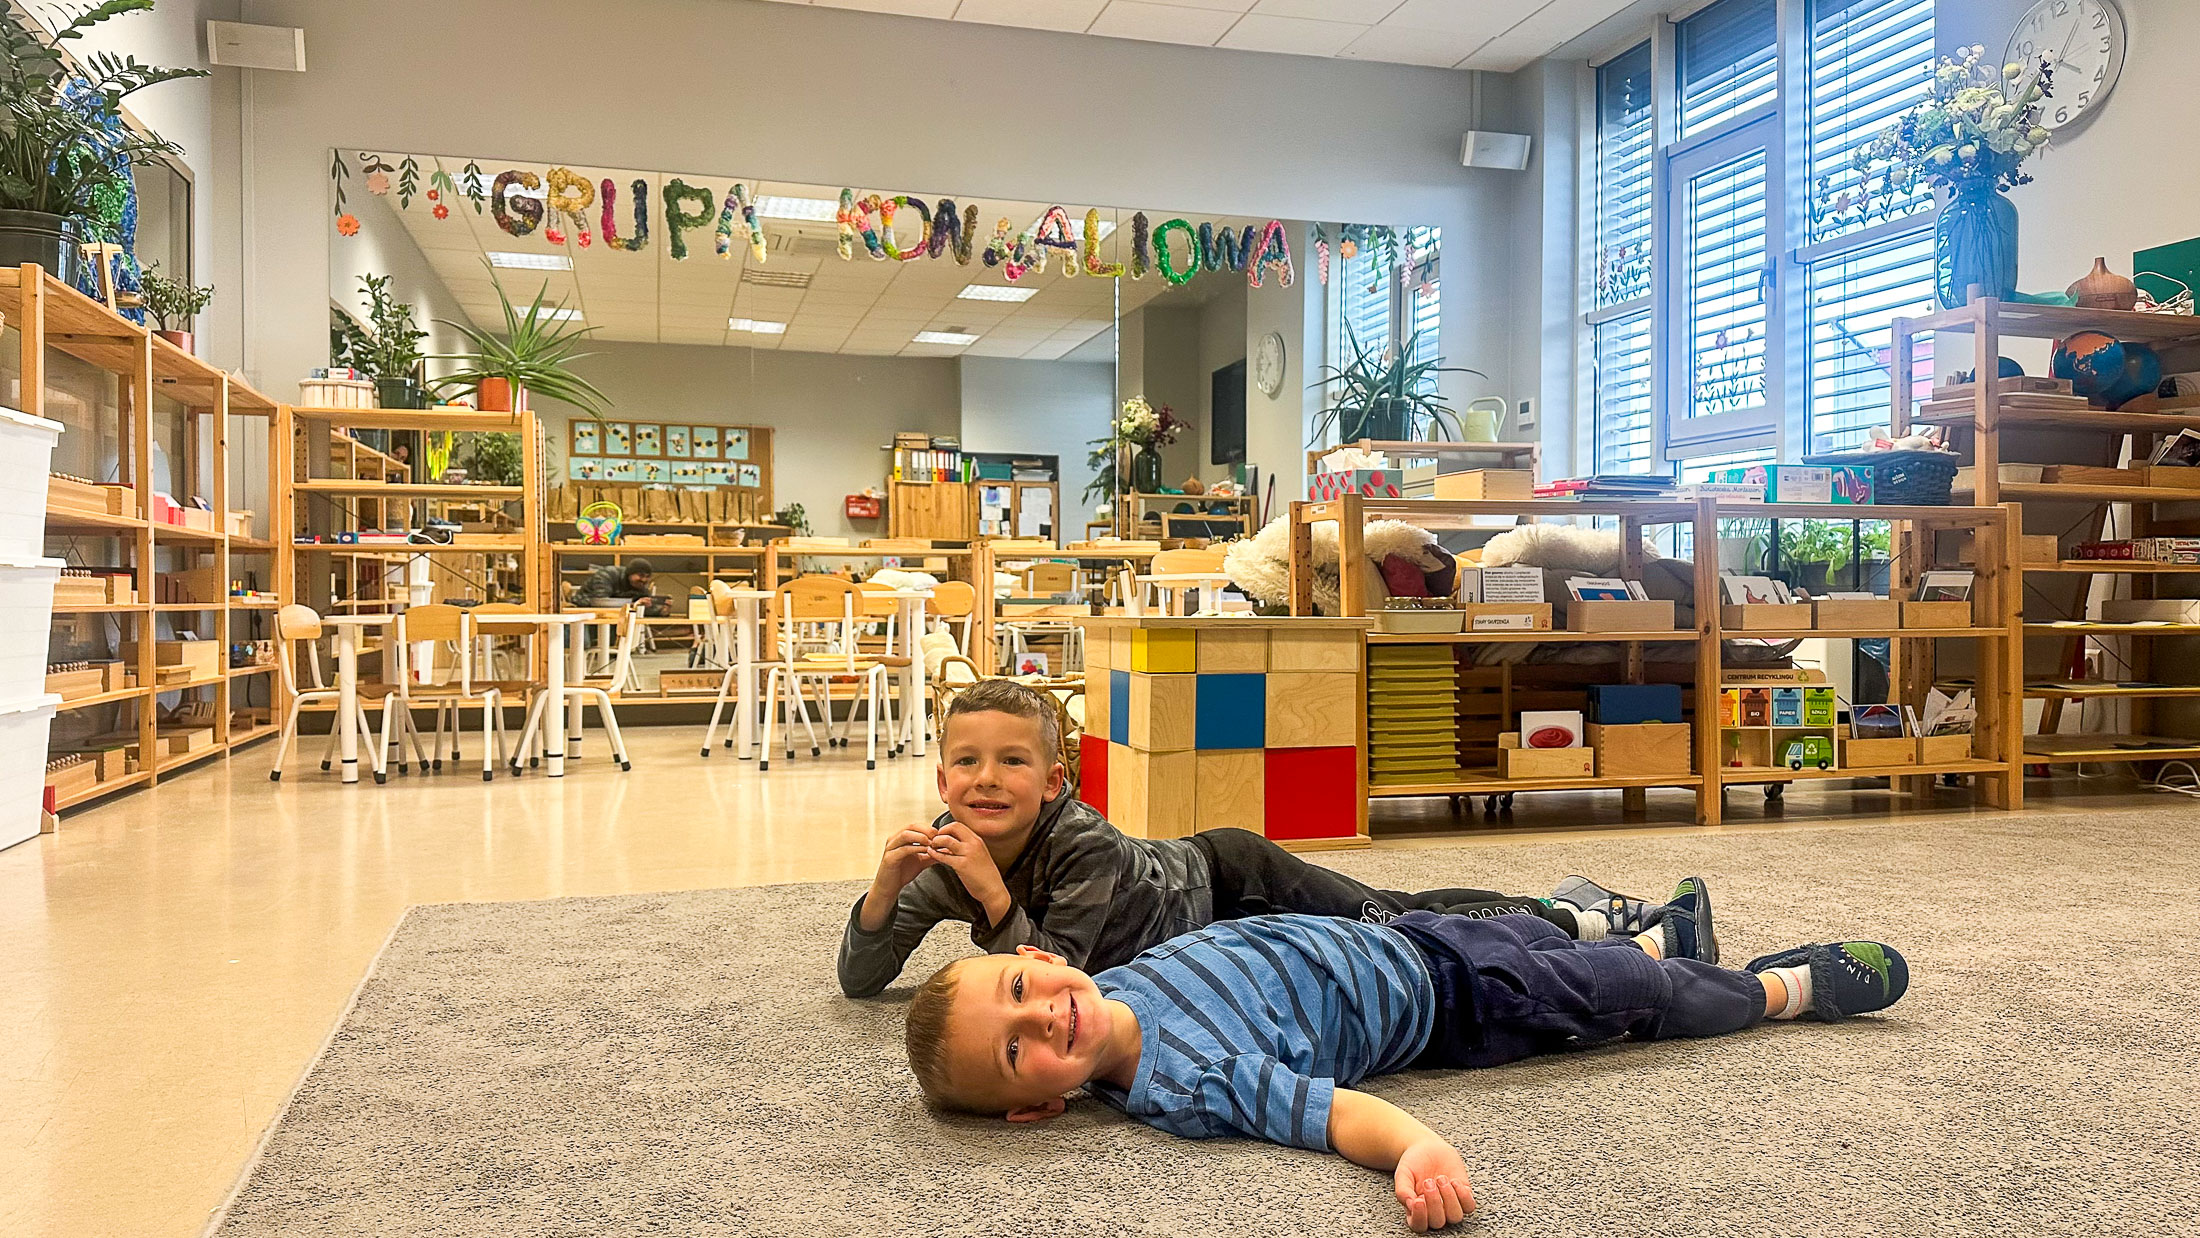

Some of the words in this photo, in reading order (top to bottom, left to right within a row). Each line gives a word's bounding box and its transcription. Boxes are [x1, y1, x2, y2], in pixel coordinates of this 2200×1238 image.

[2050, 1, 2068, 19] 12
[2031, 14, 2043, 33] 11
[2092, 12, 2105, 30] 2
[2100, 36, 2111, 53] 3
[2094, 65, 2104, 83] 4
[2077, 91, 2090, 109] 5
[2055, 106, 2068, 123] 6
[491, 167, 767, 264] GRUPA
